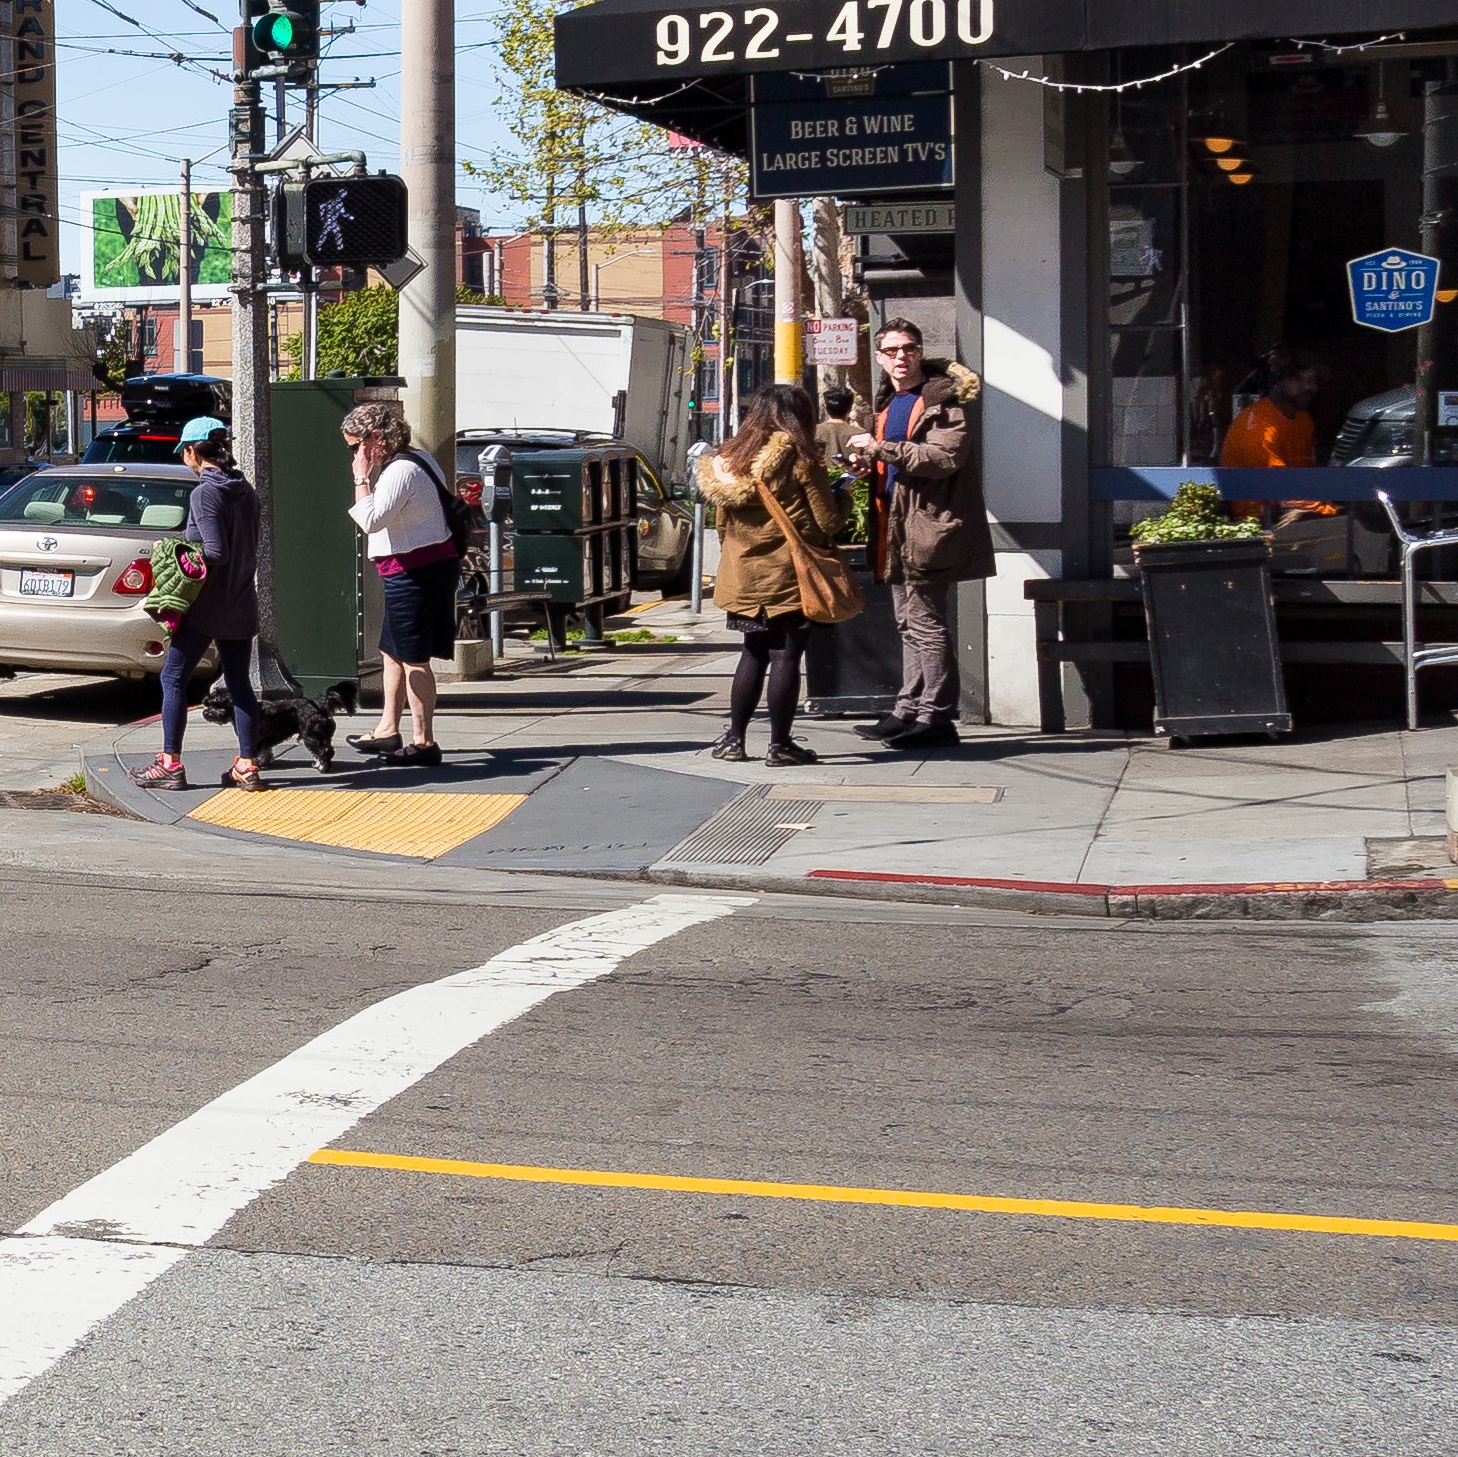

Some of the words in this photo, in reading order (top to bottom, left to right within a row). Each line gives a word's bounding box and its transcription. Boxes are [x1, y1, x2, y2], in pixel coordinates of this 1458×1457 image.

[791, 119, 840, 140] BEER
[845, 116, 858, 136] &
[863, 114, 915, 134] WINE
[762, 152, 821, 172] LARGE
[826, 146, 899, 167] SCREEN
[904, 143, 946, 162] TV'S
[16, 99, 49, 261] CENTRAL
[854, 209, 936, 229] HEATED
[1363, 271, 1425, 290] DINO
[1365, 301, 1423, 311] SANTINO'S
